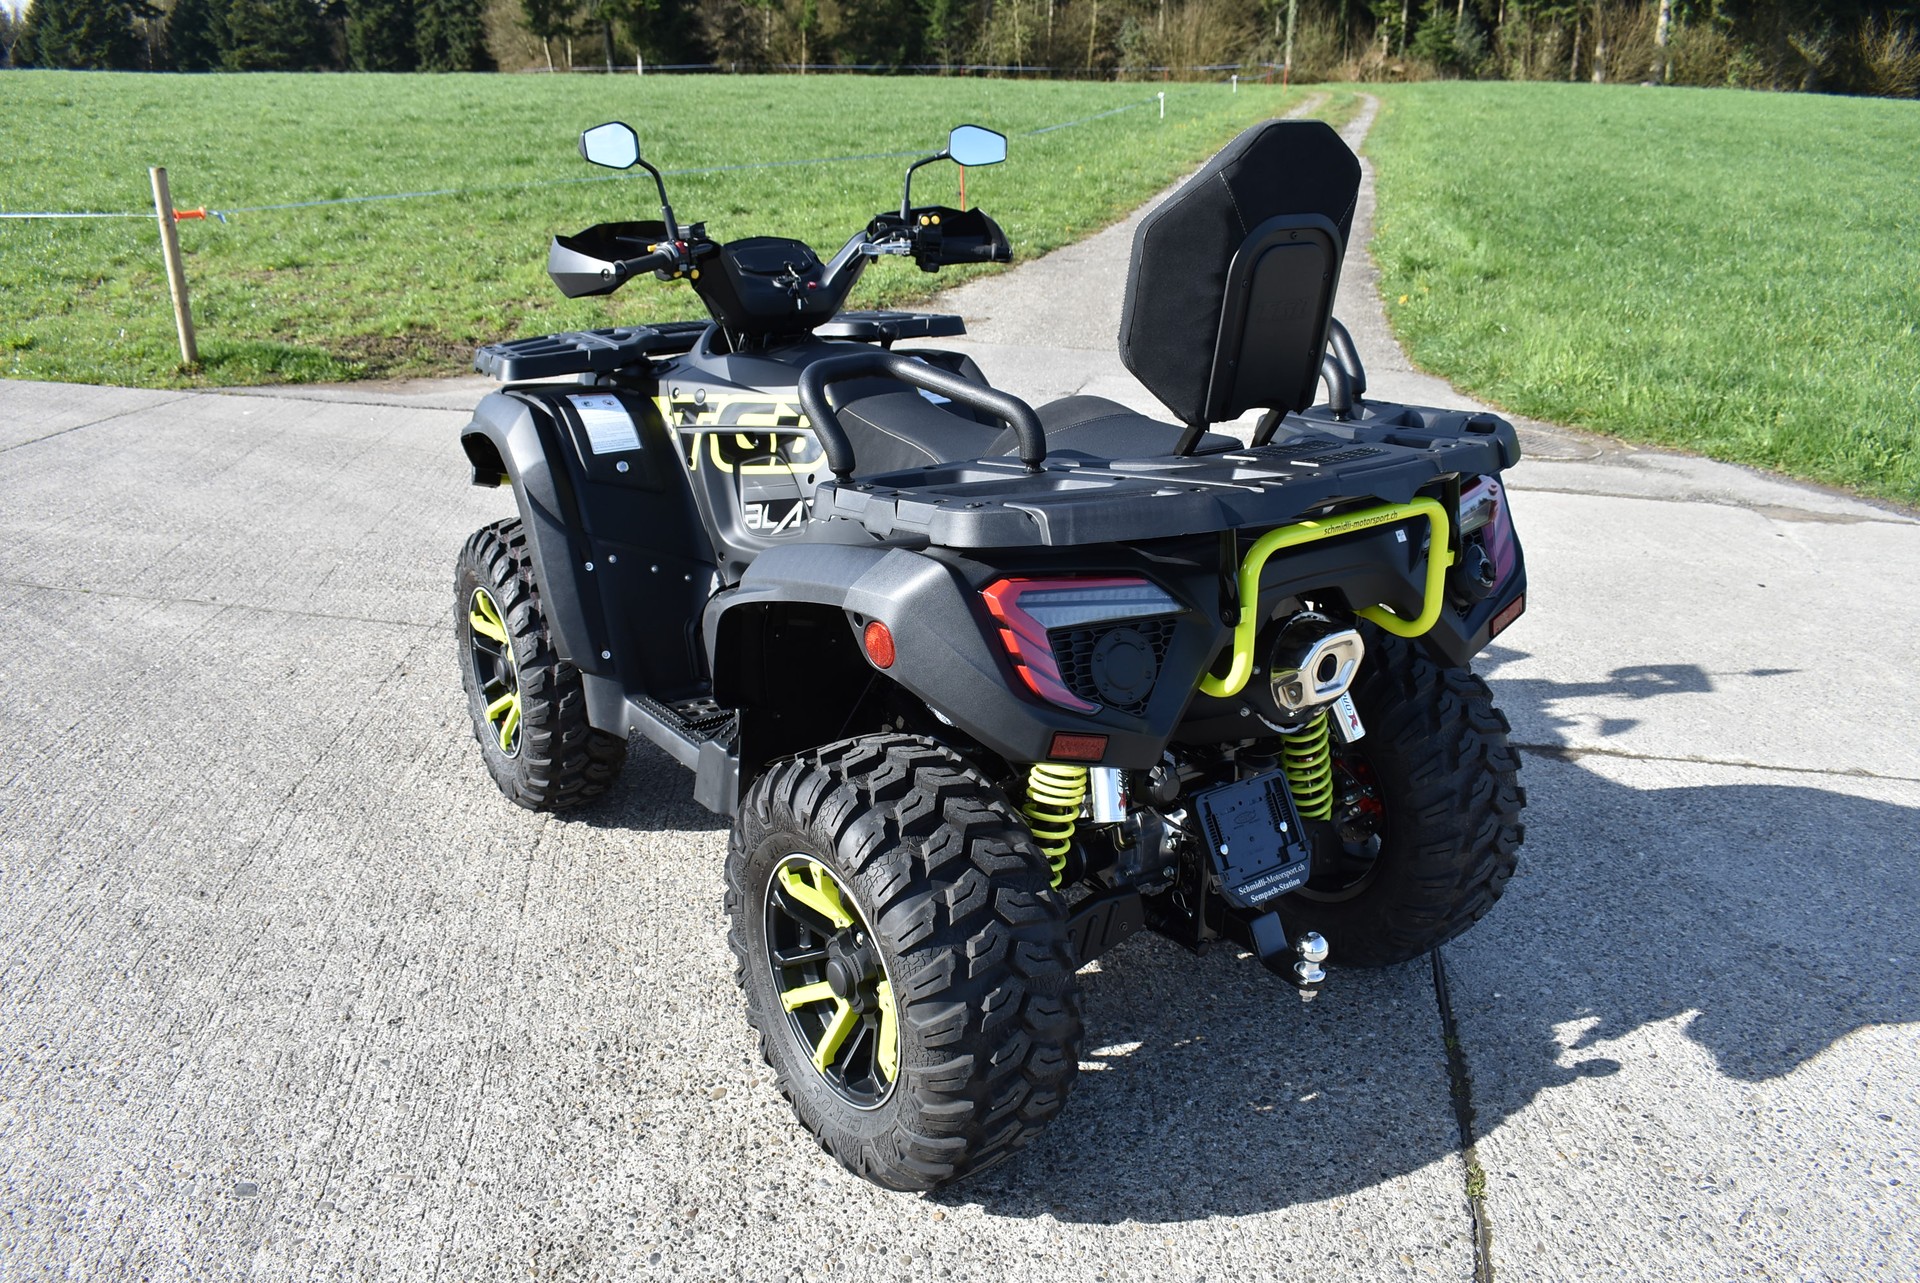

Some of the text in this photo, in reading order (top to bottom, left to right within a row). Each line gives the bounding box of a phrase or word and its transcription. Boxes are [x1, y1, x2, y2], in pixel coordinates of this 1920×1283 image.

[744, 499, 835, 536] BLA
[1323, 510, 1398, 535] schmidli-motorsport.ch
[1238, 863, 1306, 896] Schmidli-Motorsport.ch
[1250, 877, 1301, 903] Sempach-Station
